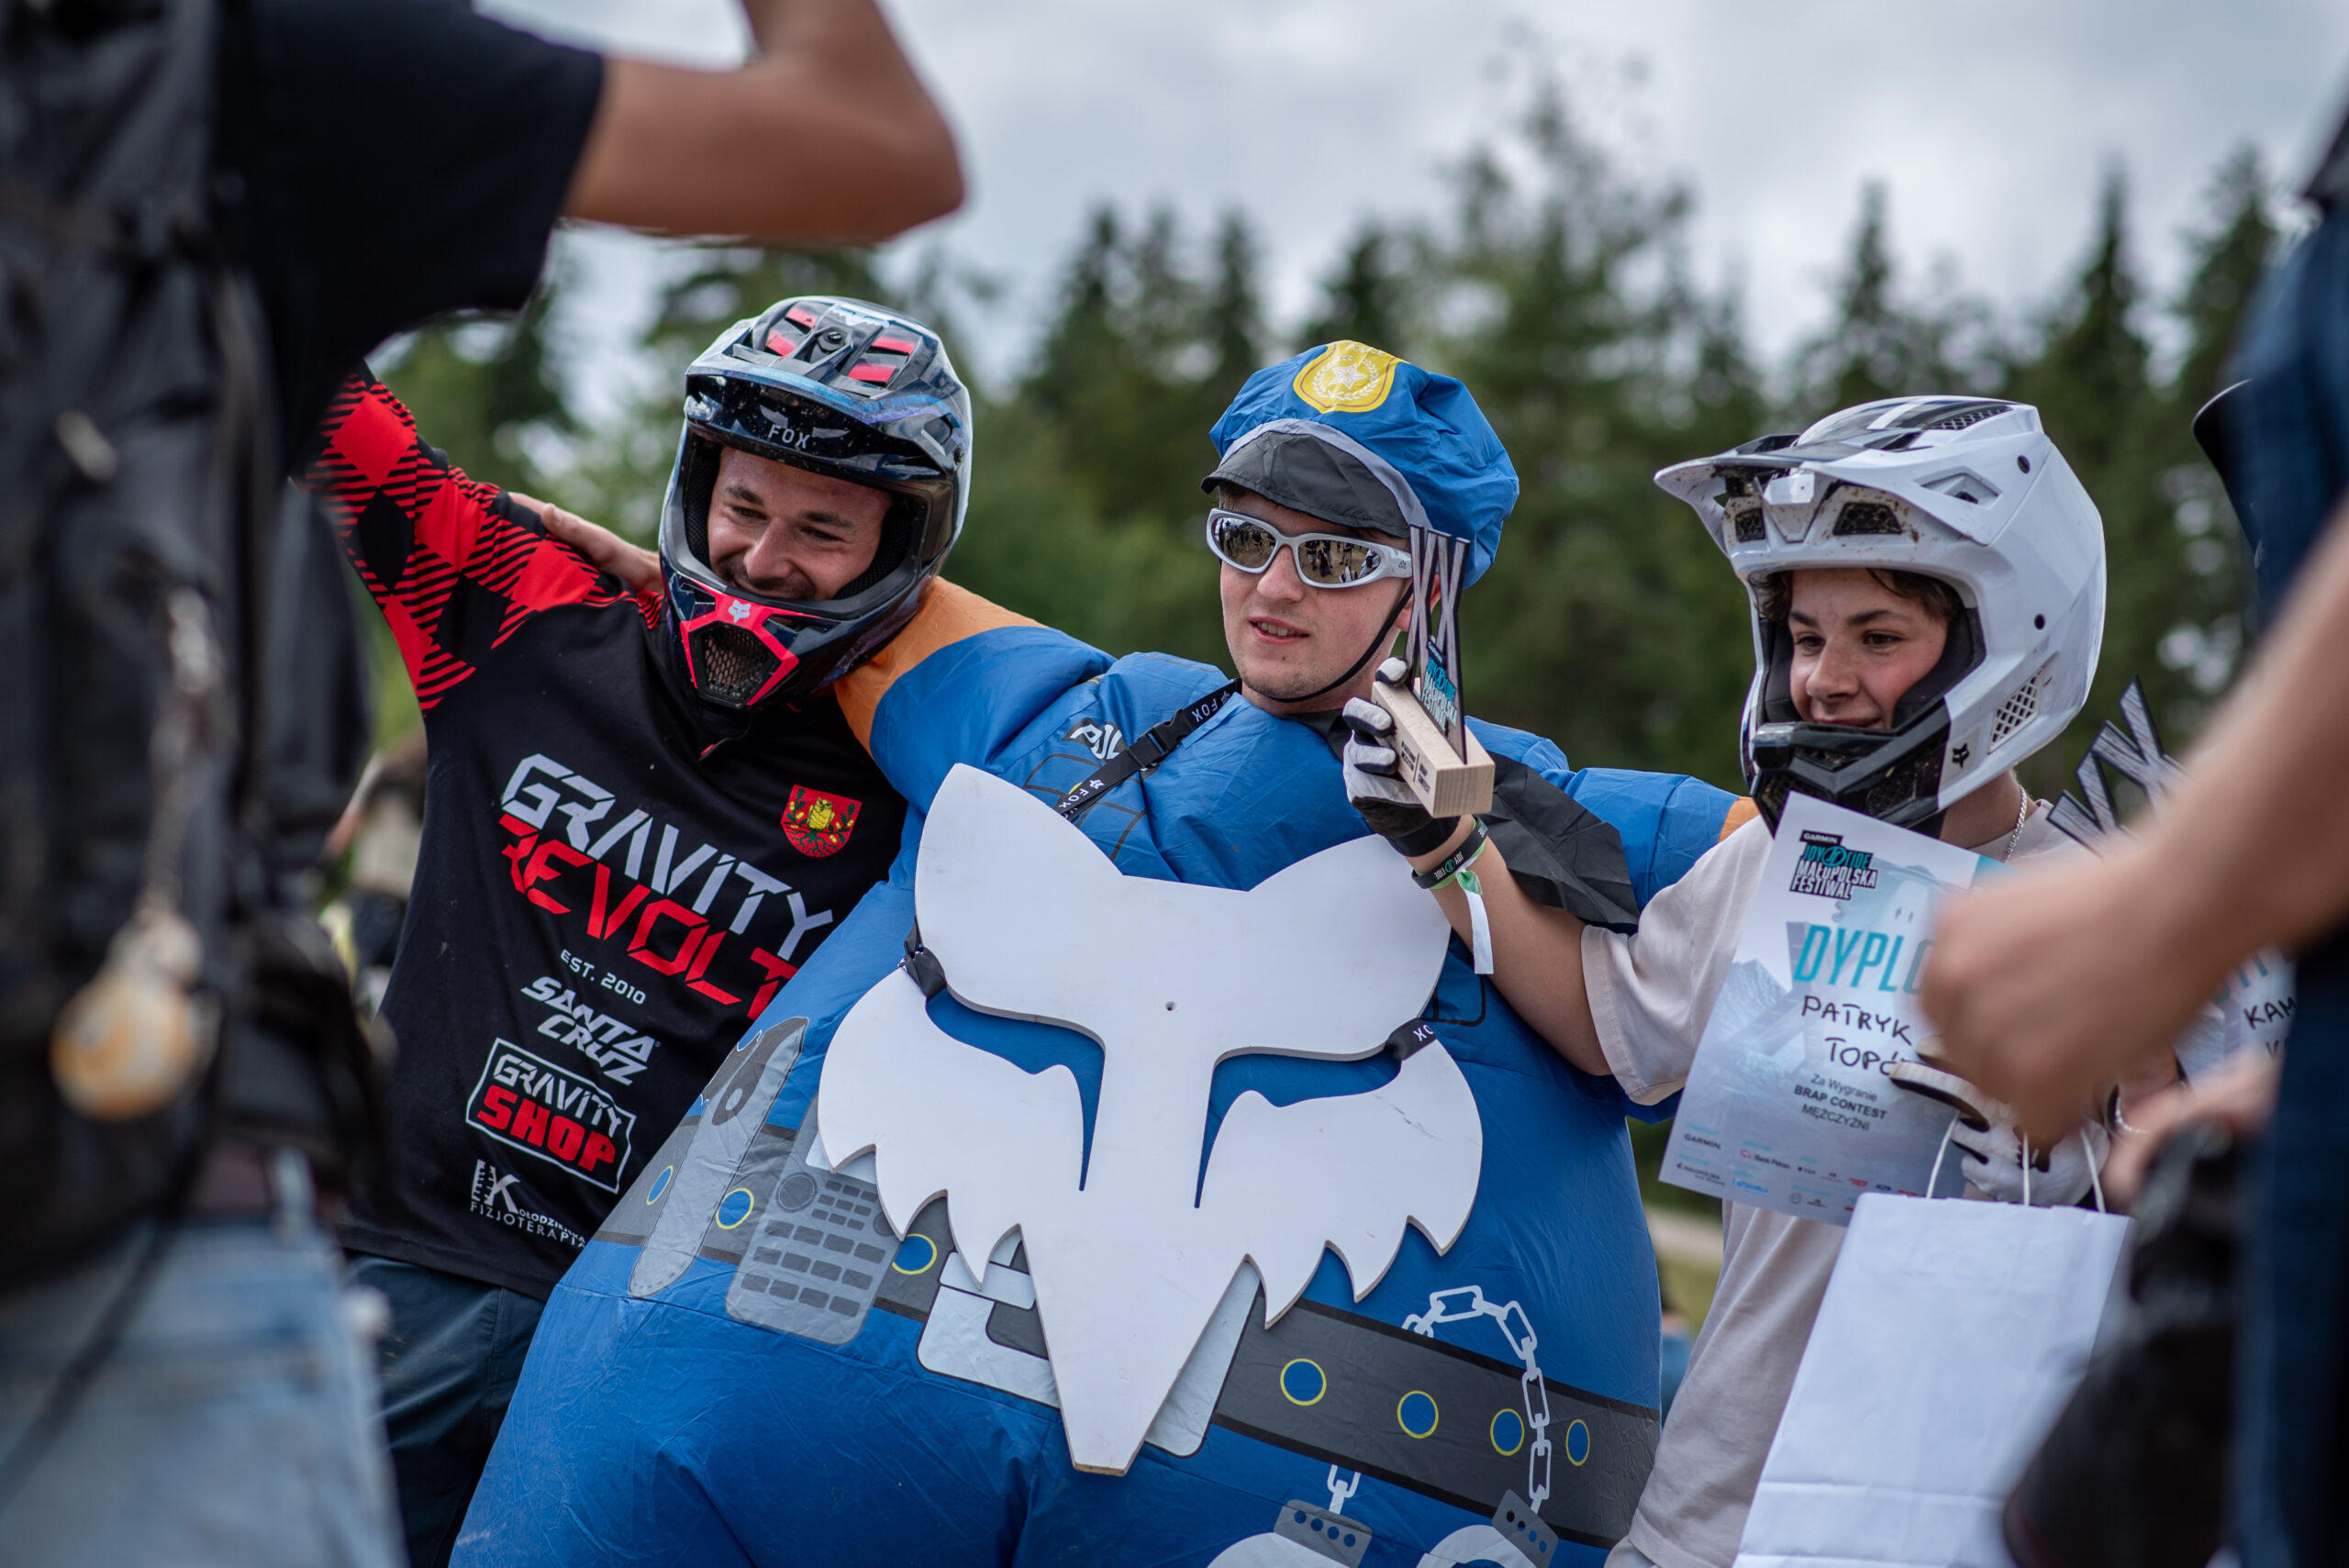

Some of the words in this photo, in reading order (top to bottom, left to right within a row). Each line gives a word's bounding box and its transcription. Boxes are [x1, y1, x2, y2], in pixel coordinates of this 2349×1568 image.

[768, 424, 810, 449] FOX
[1191, 698, 1219, 723] FOX
[1058, 787, 1090, 808] FOX
[501, 753, 833, 961] GRAVITY
[1791, 874, 1852, 899] FESTIWAL
[499, 813, 798, 1020] REVOLT
[561, 949, 596, 981] EST.
[600, 973, 647, 1005] 2010
[1793, 924, 1936, 995] DYPLO
[520, 976, 655, 1062] SANTA
[1801, 995, 1913, 1047] PATRYK
[2243, 996, 2298, 1029] KAM
[538, 1014, 648, 1086] CRUZ
[494, 1054, 622, 1138] GRAVITY
[1794, 1084, 1828, 1106] BRAP
[1830, 1095, 1887, 1119] CONTEST
[477, 1084, 616, 1172] SHOP
[471, 1201, 585, 1248] FIZJOTERAPIA
